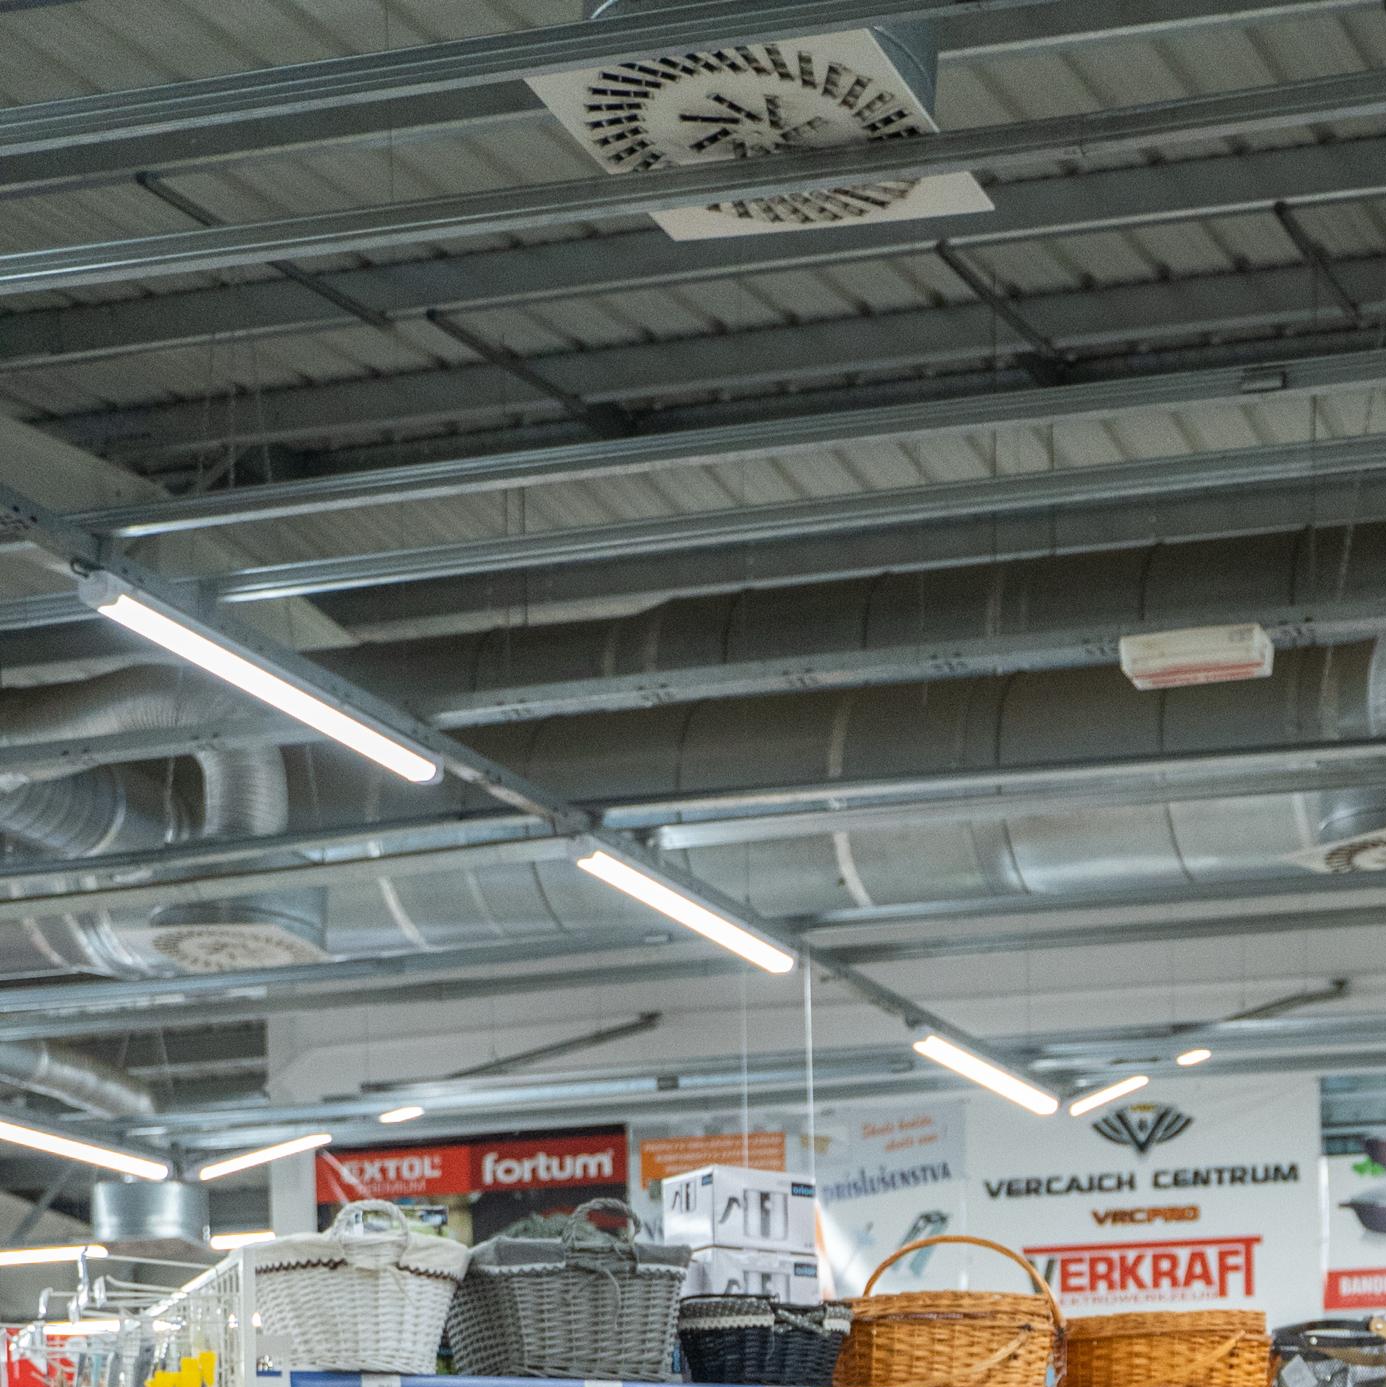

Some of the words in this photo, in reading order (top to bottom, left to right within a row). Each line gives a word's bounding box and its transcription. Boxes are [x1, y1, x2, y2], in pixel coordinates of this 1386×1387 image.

[340, 1154, 441, 1184] EXTOL
[482, 1149, 614, 1186] fortum
[984, 1171, 1137, 1199] VERCAJCH
[1153, 1161, 1300, 1190] CENTRUM
[1023, 1234, 1262, 1297] VERKRAFT
